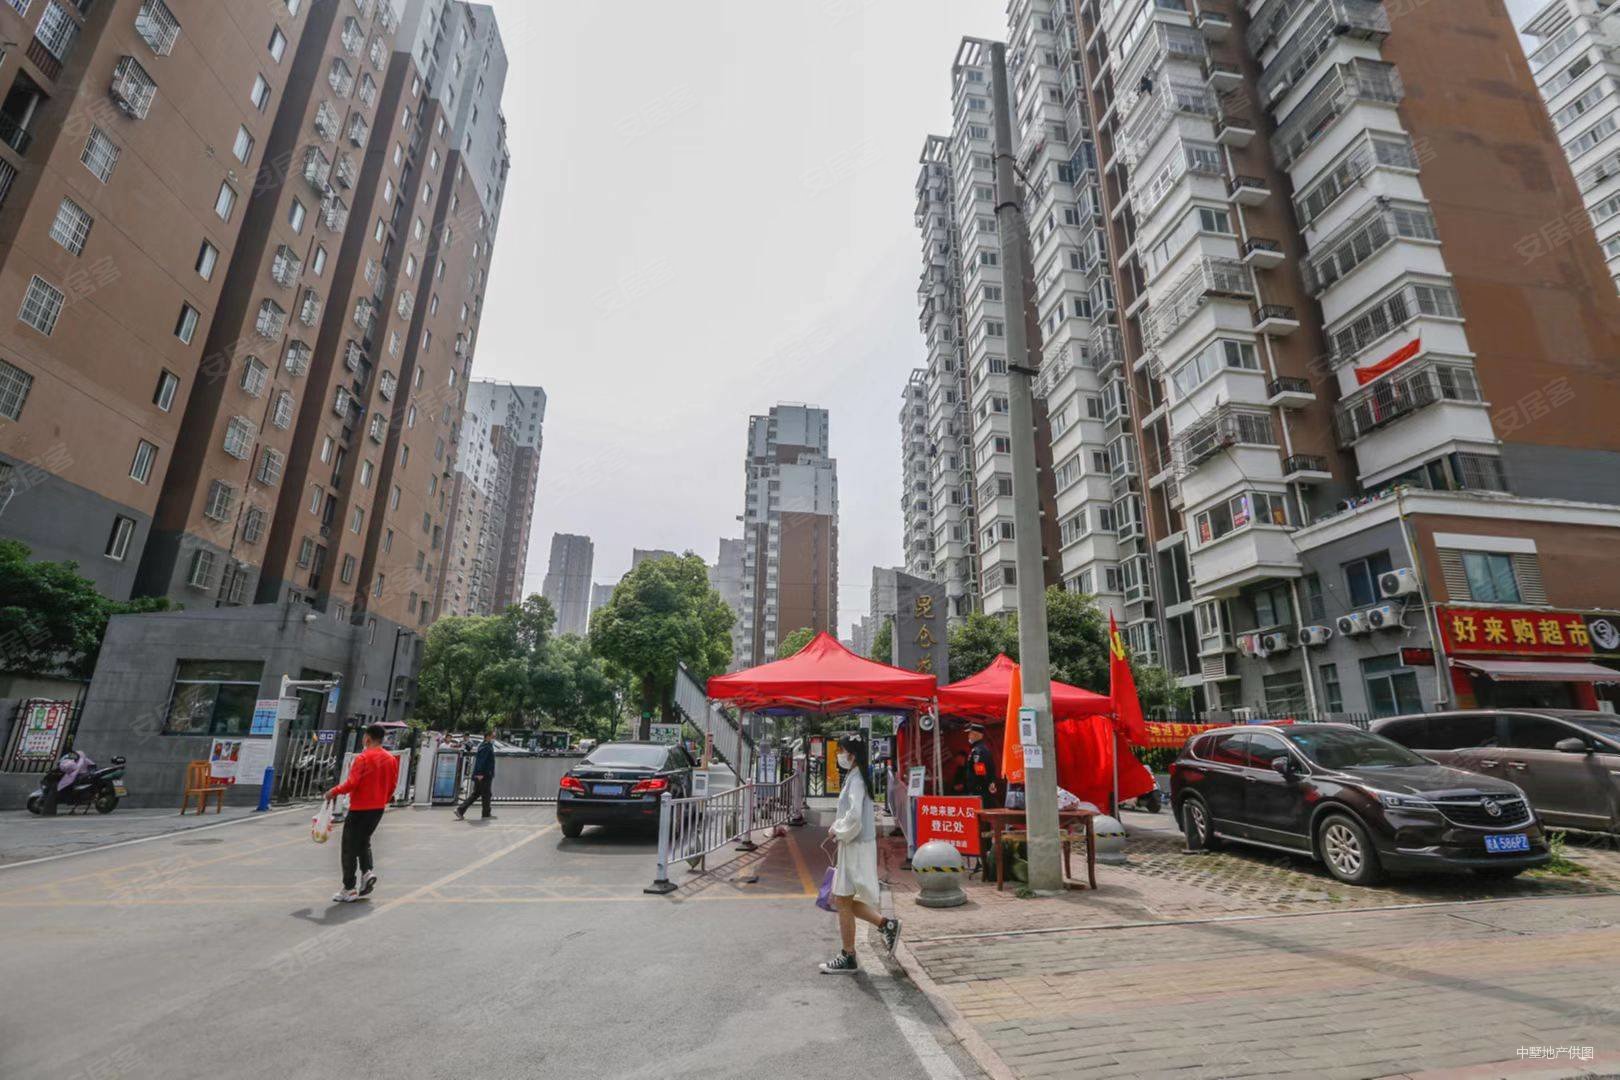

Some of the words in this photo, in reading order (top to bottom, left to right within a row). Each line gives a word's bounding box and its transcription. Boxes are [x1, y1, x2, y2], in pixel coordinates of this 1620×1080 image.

[1453, 615, 1590, 647] 好来购超市
[921, 804, 975, 818] 外地来肥人员
[931, 820, 965, 833] 登记处
